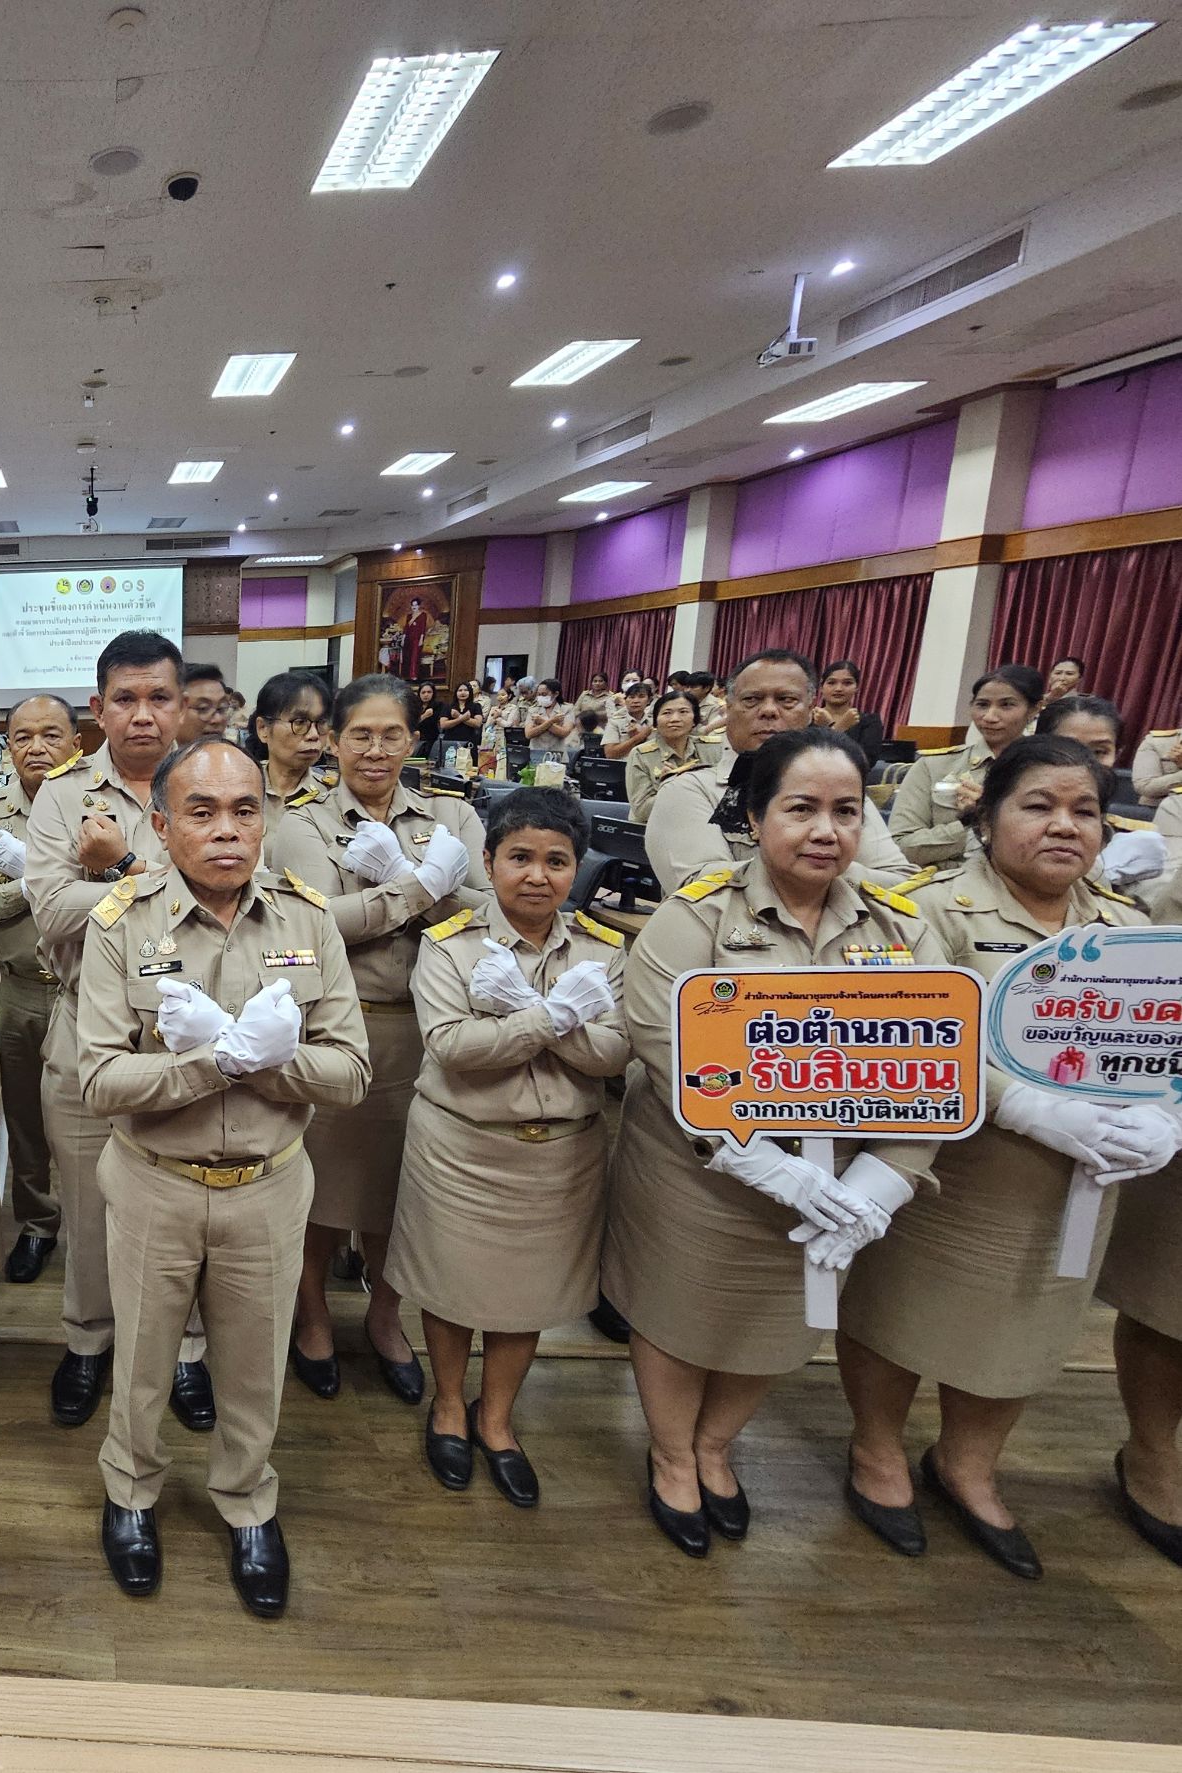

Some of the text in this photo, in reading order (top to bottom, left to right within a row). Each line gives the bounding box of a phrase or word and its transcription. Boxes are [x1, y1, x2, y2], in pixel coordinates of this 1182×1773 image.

[597, 823, 618, 834] acer
[744, 990, 950, 1002] สำนักงานพัฒนาชุมชนจังหวัดนครศรีธรรมราช
[1035, 990, 1121, 1020] งดรับ
[748, 1008, 961, 1046] ต่อต้านการ
[750, 1047, 957, 1091] รับสินบน
[734, 1094, 961, 1124] จากการปฏิบัติหน้าที่
